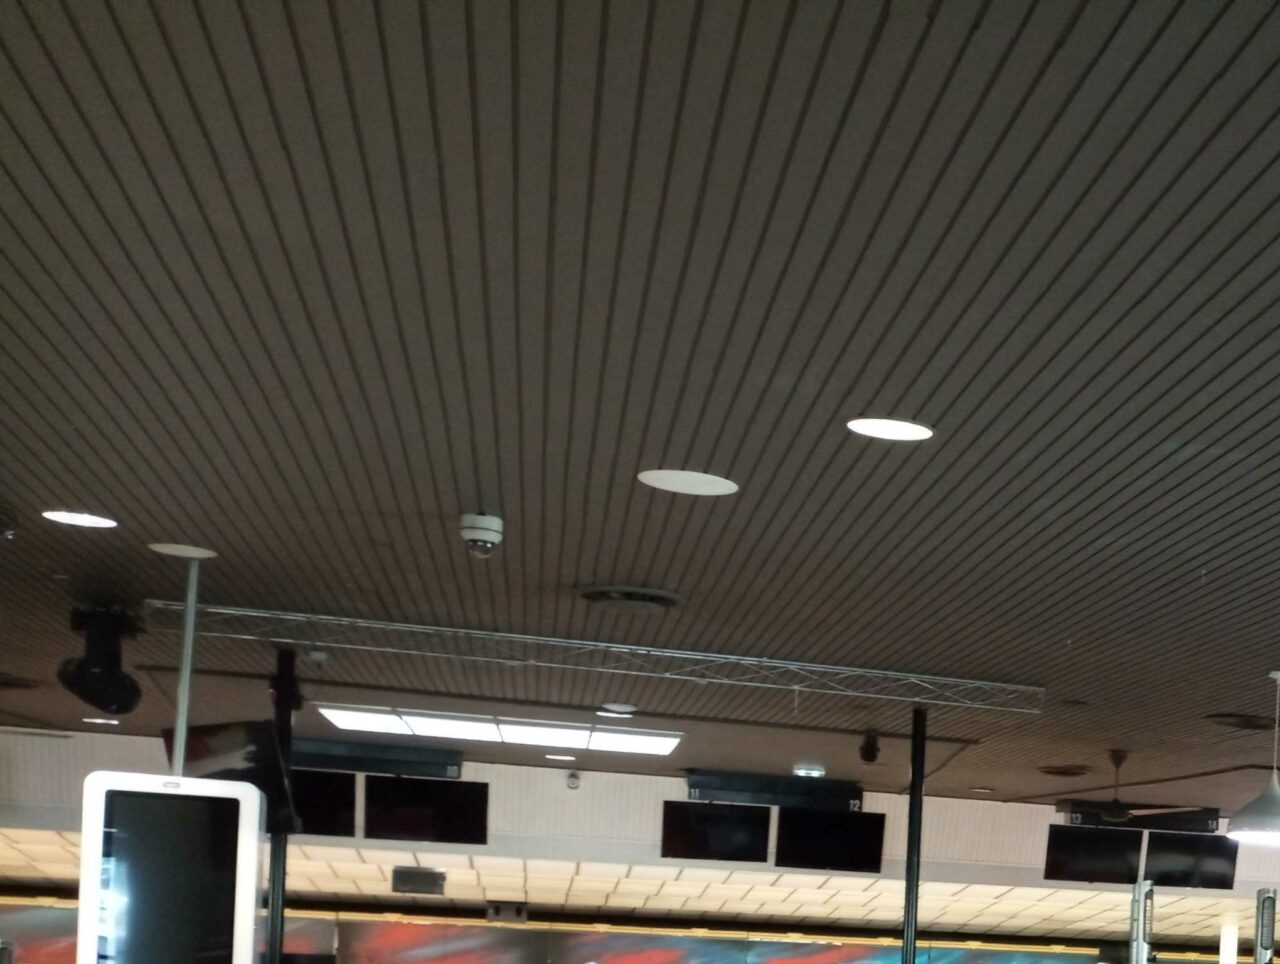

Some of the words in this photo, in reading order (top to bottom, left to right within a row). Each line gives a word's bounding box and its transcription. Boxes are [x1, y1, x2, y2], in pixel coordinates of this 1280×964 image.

[850, 799, 860, 812] 12
[1071, 813, 1082, 824] 13
[1207, 820, 1217, 830] 14
